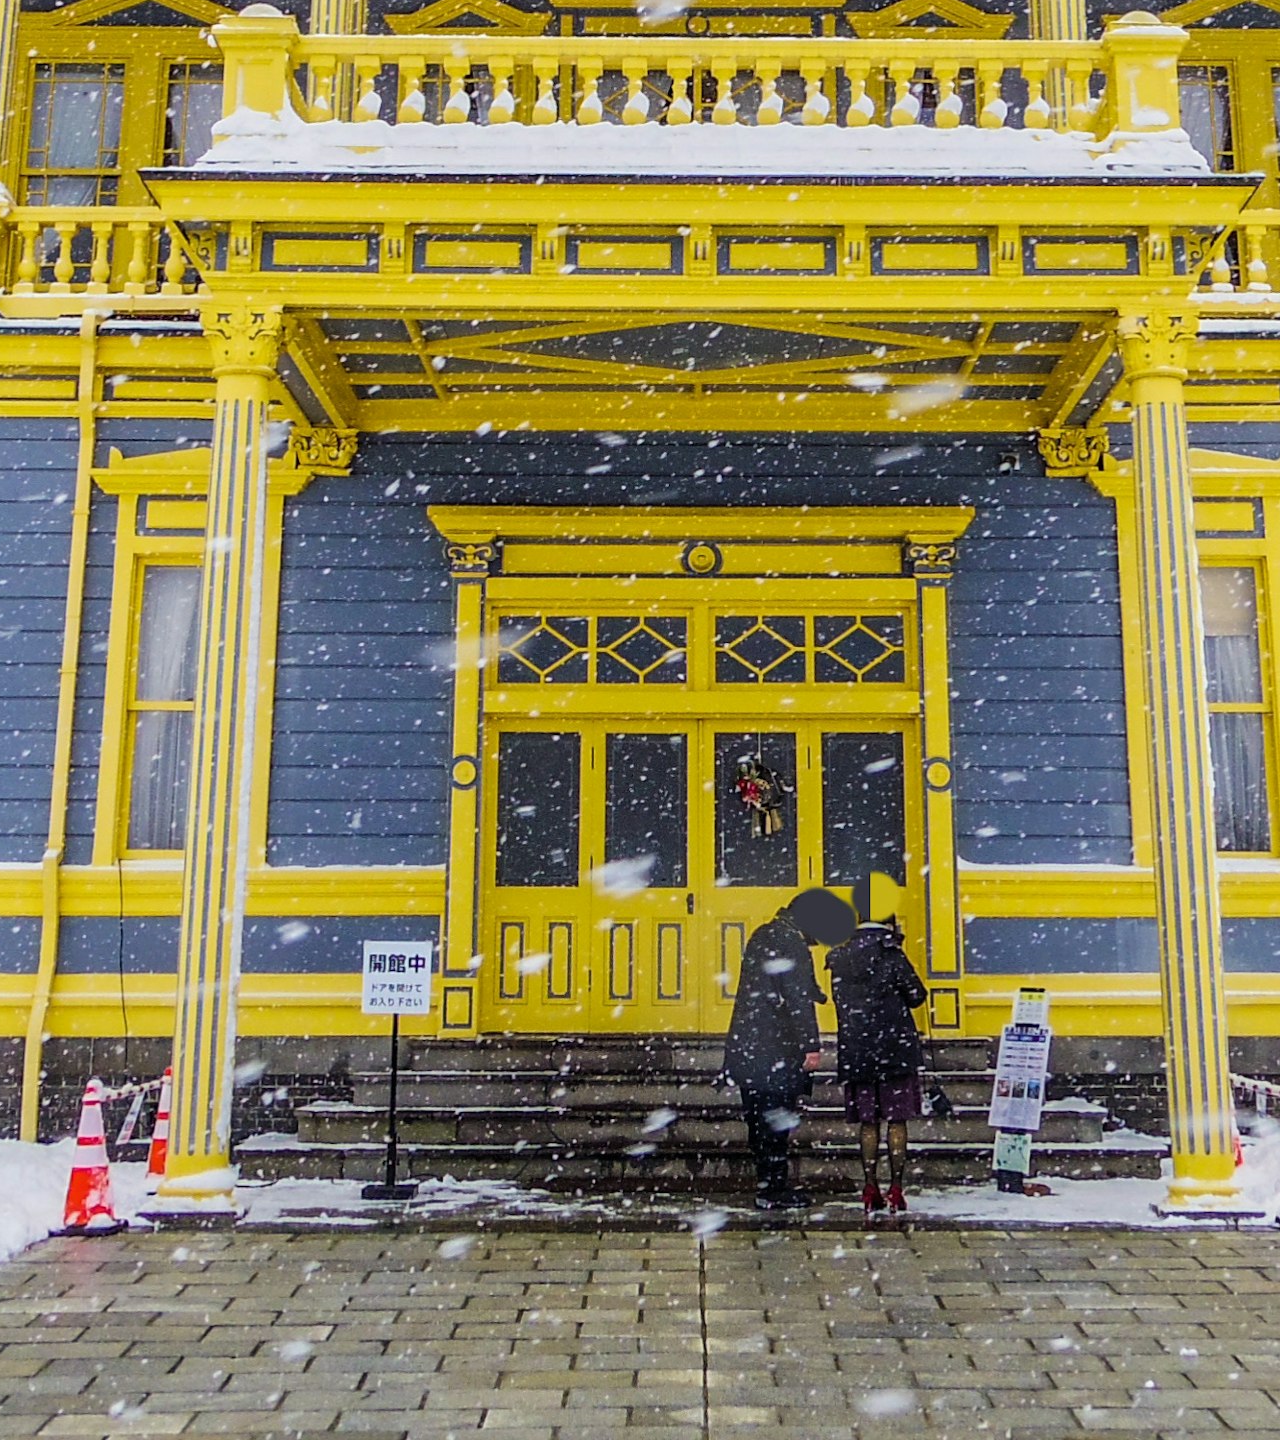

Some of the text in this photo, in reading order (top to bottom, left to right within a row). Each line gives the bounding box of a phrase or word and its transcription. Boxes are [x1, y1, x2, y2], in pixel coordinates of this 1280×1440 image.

[369, 954, 426, 973] 開館中
[372, 983, 422, 992] ドアを開けて
[369, 997, 422, 1006] お入り下さい
